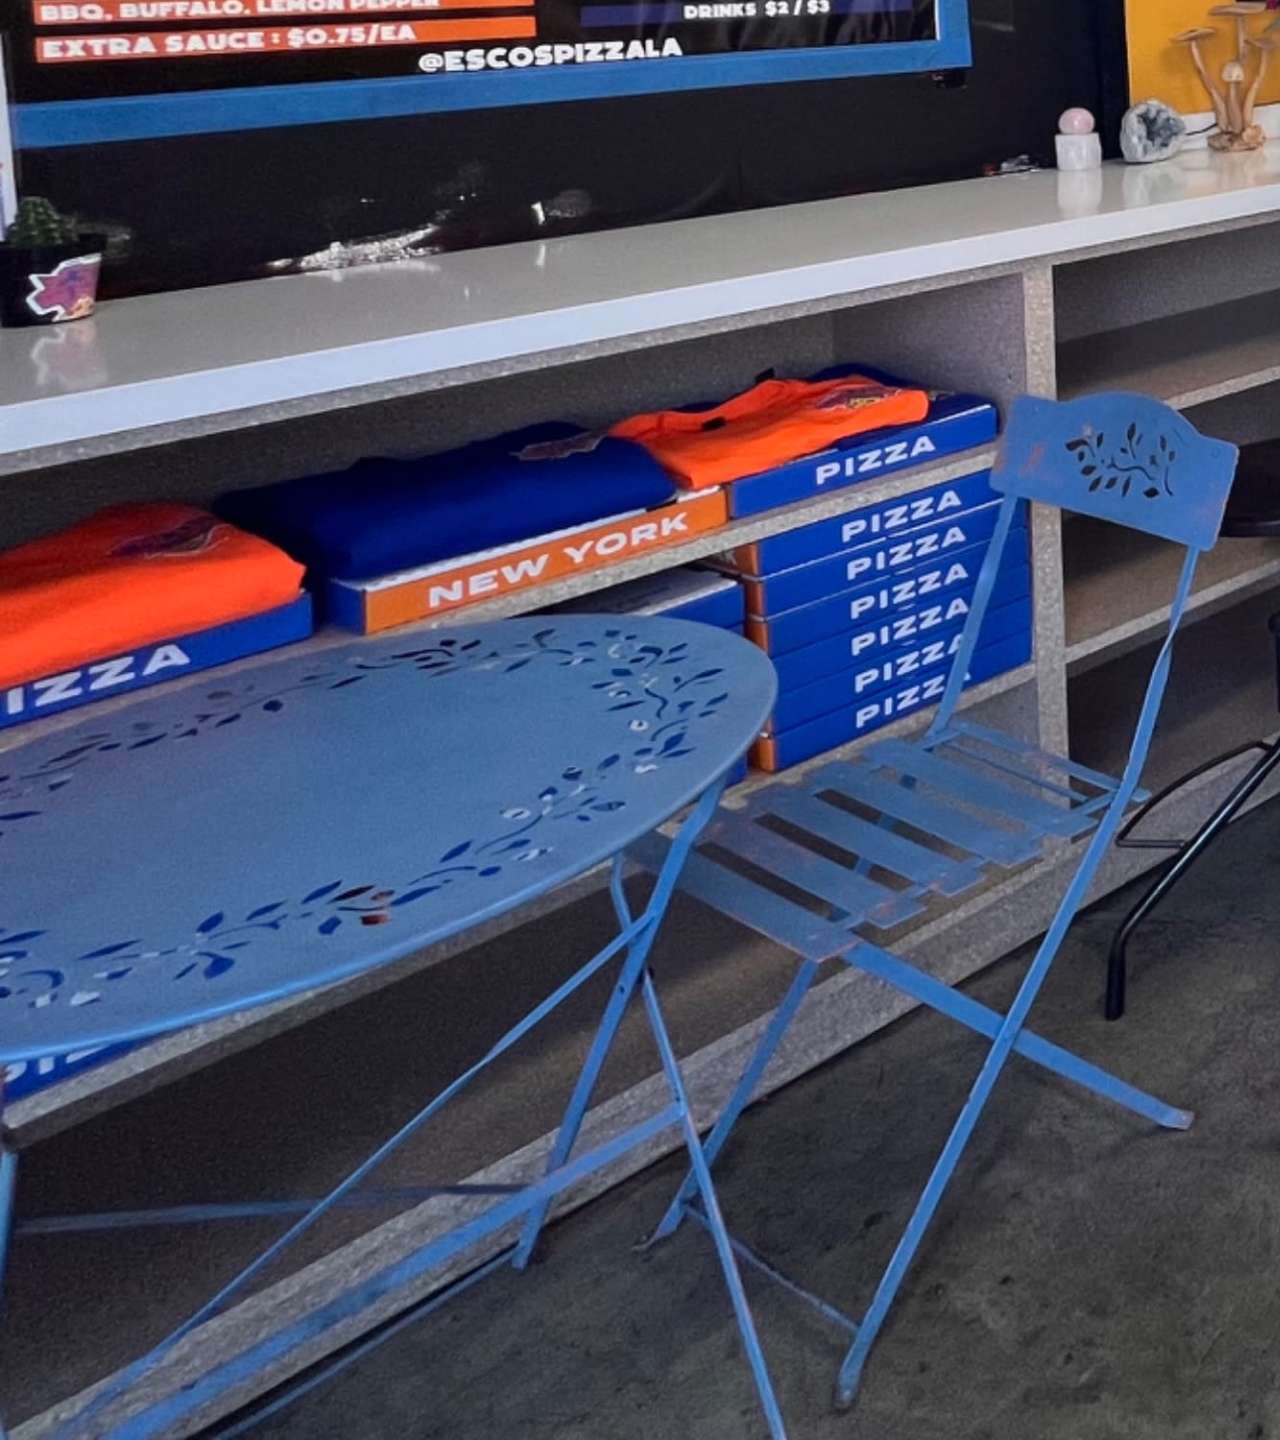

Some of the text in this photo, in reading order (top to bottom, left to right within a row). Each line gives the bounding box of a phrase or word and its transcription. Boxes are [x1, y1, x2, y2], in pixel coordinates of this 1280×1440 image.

[683, 2, 756, 20] DRINKS
[764, 0, 789, 17] $2
[43, 37, 156, 59] EXTRA
[165, 32, 264, 52] SAUCE
[287, 25, 417, 48] $0.75/EA
[418, 37, 682, 73] @ESCOSPIZZALA
[815, 435, 936, 486] PIZZA
[841, 490, 963, 543] PIZZA
[428, 512, 688, 609] NEW YORK
[846, 526, 967, 581] PIZZA
[850, 562, 969, 620] PIZZA
[851, 598, 970, 657] PIZZA
[856, 673, 947, 729] PIZZ
